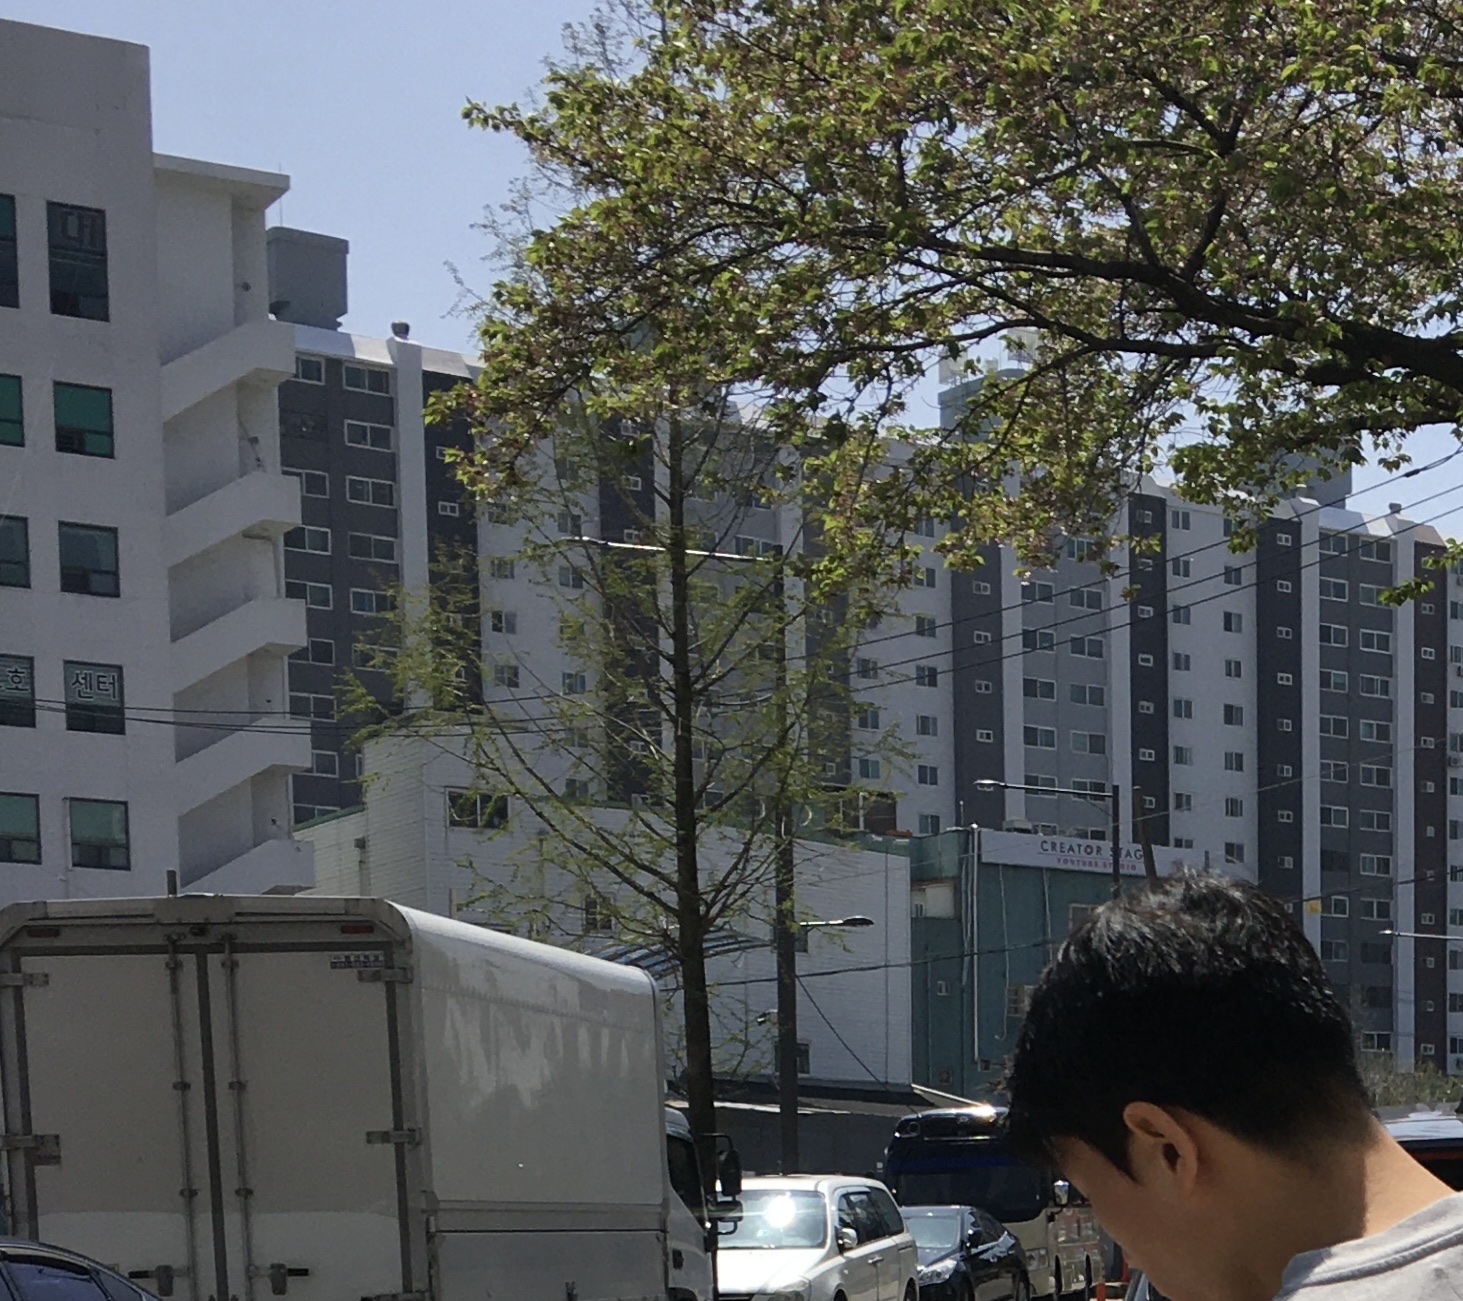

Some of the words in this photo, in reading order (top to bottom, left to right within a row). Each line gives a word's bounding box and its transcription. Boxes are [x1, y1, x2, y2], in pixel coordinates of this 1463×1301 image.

[0, 667, 29, 692] 호
[71, 672, 117, 699] 센터
[1040, 840, 1103, 856] CREATOR
[1109, 847, 1144, 860] STAG
[1103, 861, 1137, 871] STDIO
